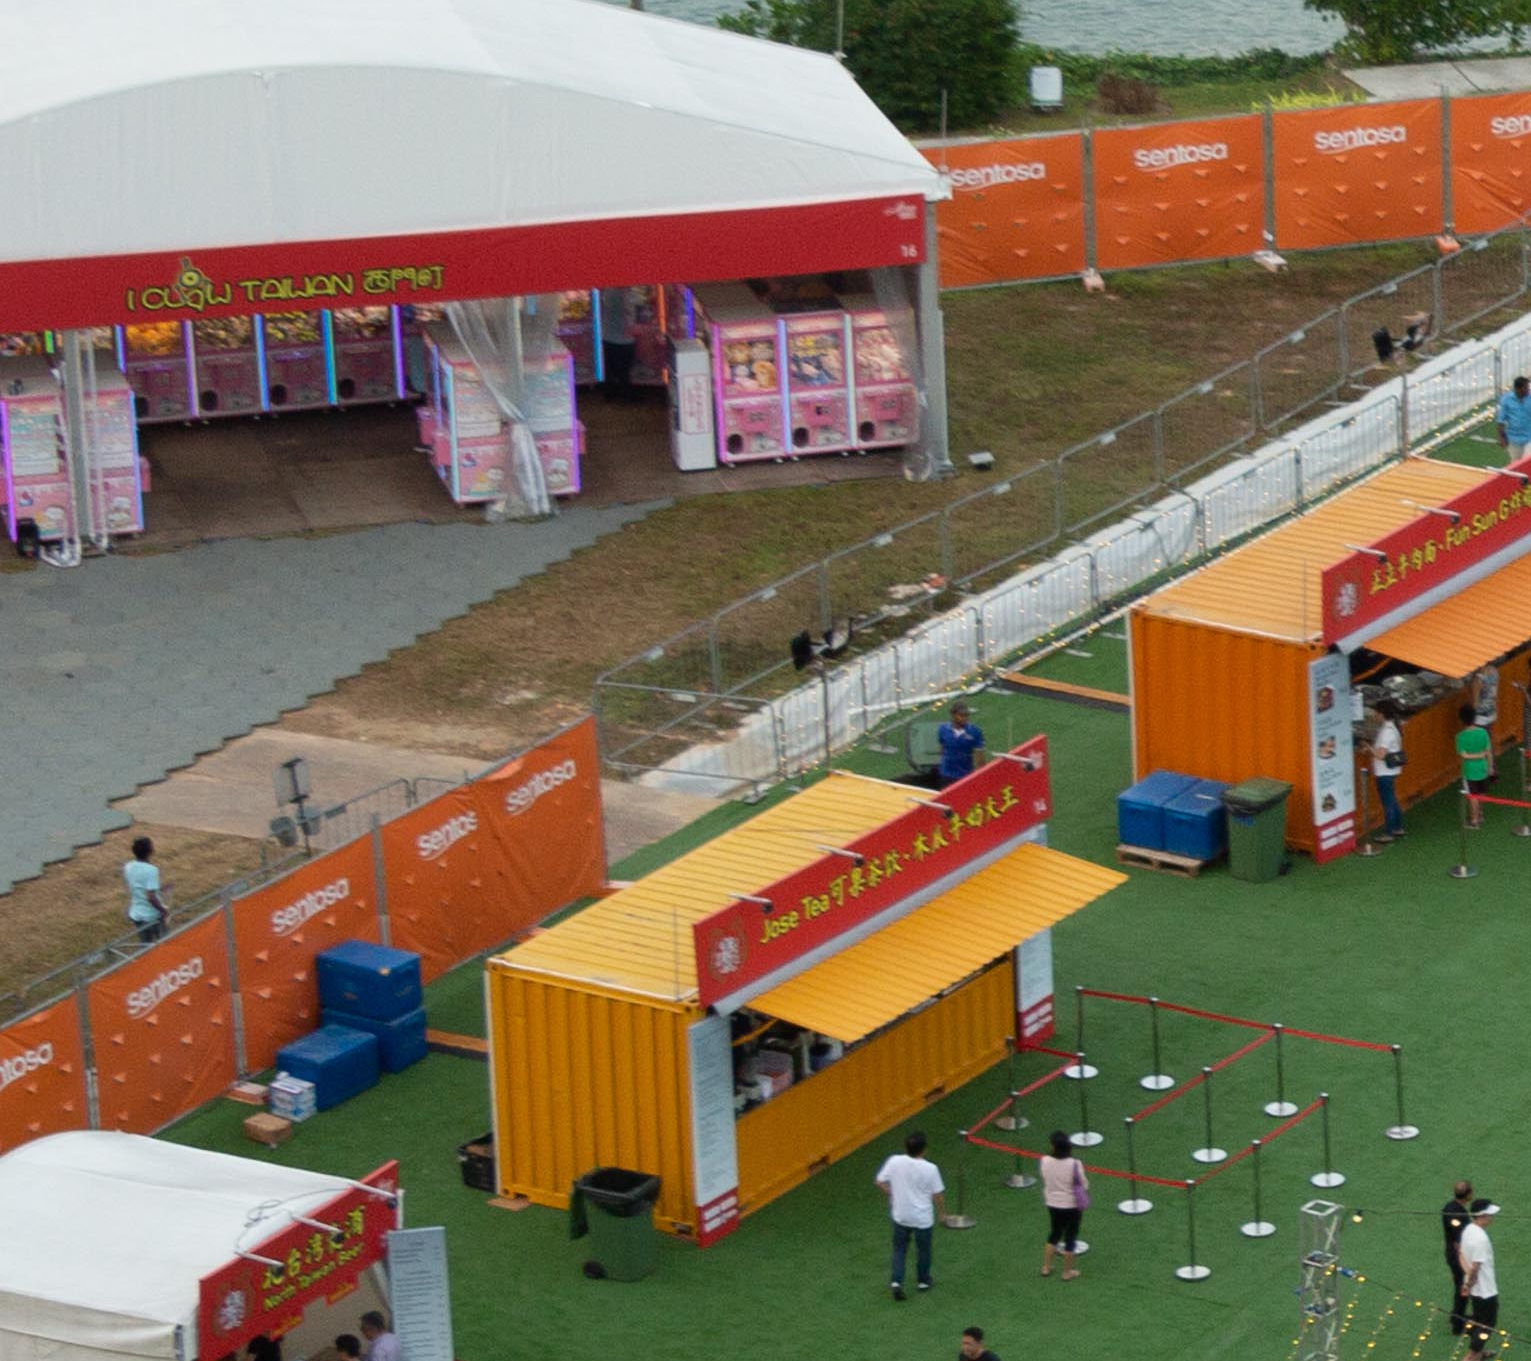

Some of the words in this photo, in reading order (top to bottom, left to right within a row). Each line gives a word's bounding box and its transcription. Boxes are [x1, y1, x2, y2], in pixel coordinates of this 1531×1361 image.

[1133, 141, 1229, 171] sentosa
[1314, 124, 1407, 153] sentosa
[951, 162, 1046, 188] sentosa
[238, 274, 354, 303] TAIWAN
[507, 758, 577, 814] sentosa
[271, 877, 350, 936] sentosa
[760, 908, 800, 944] Jose
[801, 894, 830, 920] Tea
[126, 956, 203, 1018] sentosa
